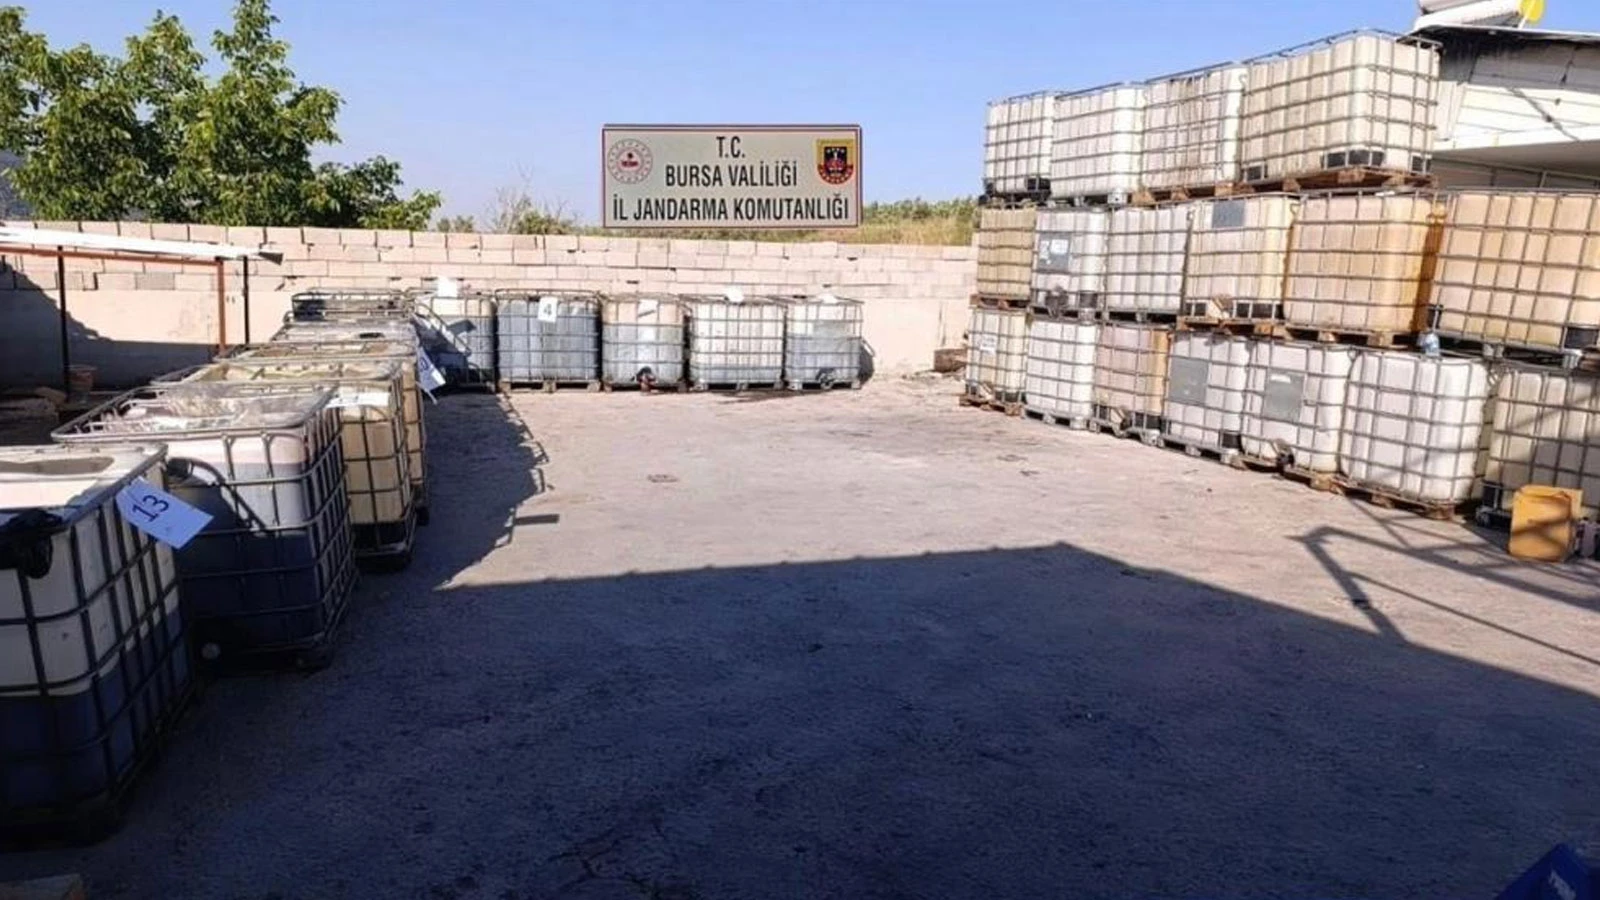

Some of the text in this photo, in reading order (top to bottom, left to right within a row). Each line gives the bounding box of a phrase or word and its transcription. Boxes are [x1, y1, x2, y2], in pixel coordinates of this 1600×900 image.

[716, 136, 746, 158] T.C.
[665, 164, 723, 187] BURSA
[728, 161, 798, 187] VALİLİĞİ
[613, 193, 849, 221] İL JANDARMA KOMUTANLIĞI
[132, 494, 169, 522] 13
